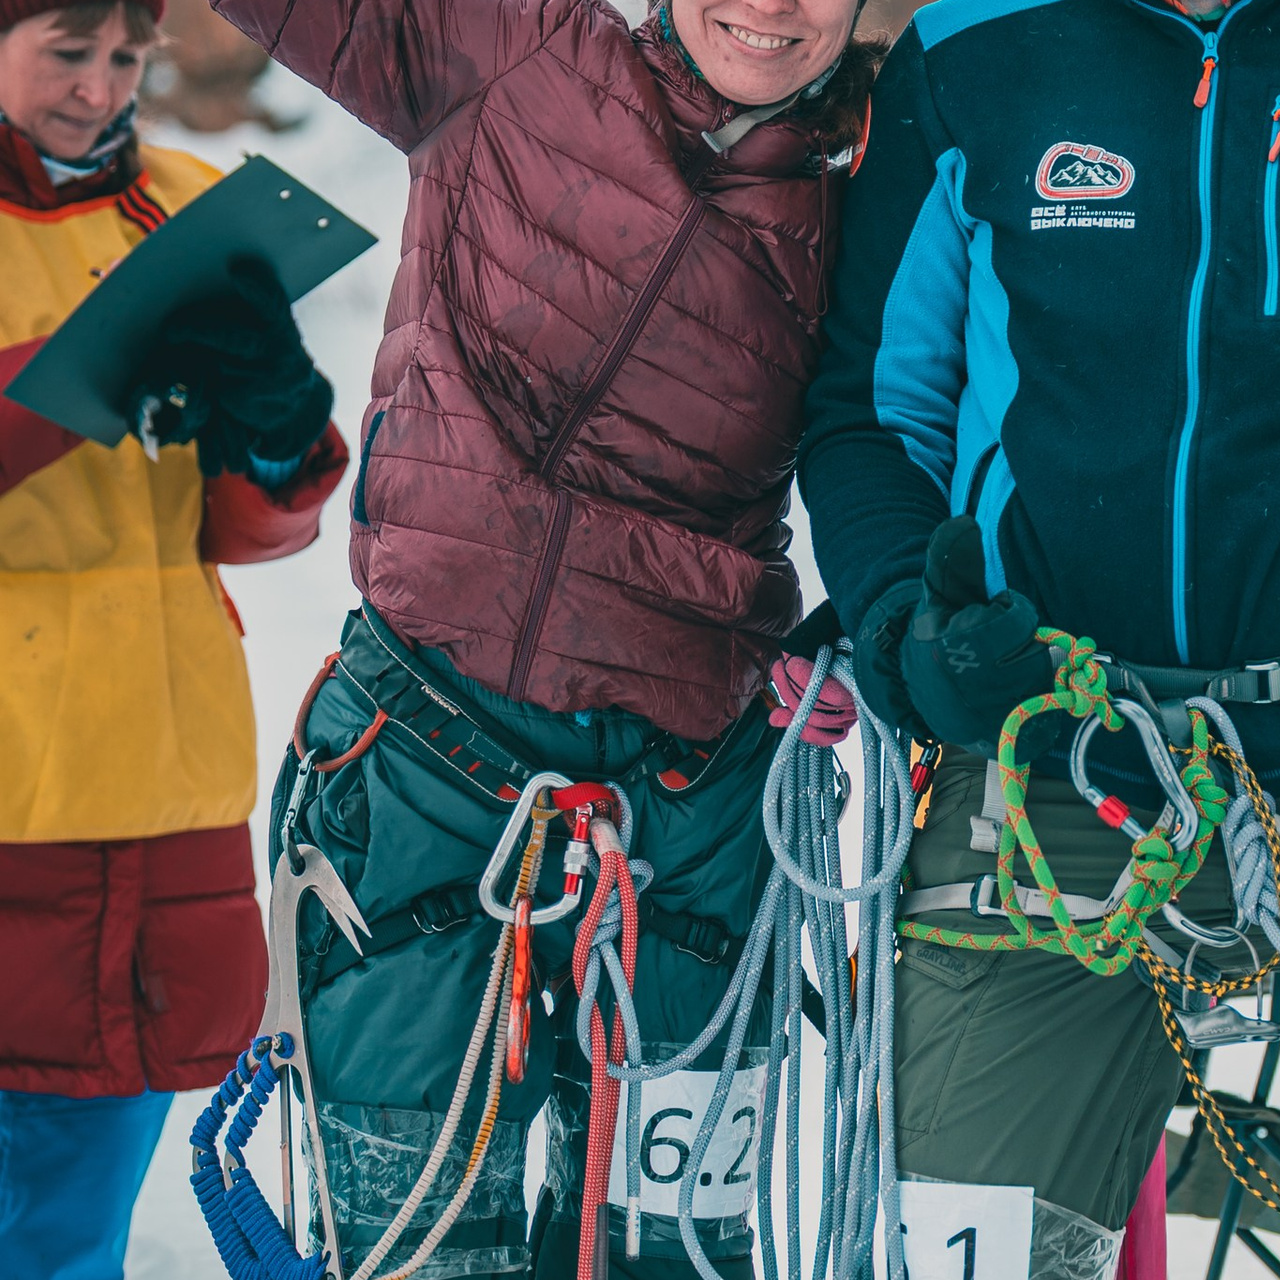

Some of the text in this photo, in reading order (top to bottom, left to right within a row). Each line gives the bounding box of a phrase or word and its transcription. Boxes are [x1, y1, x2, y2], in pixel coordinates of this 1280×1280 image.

[1031, 217, 1136, 231] ВЫКЛЮЧЕНО
[916, 949, 967, 975] GRAYLING
[639, 1106, 756, 1188] 6.2
